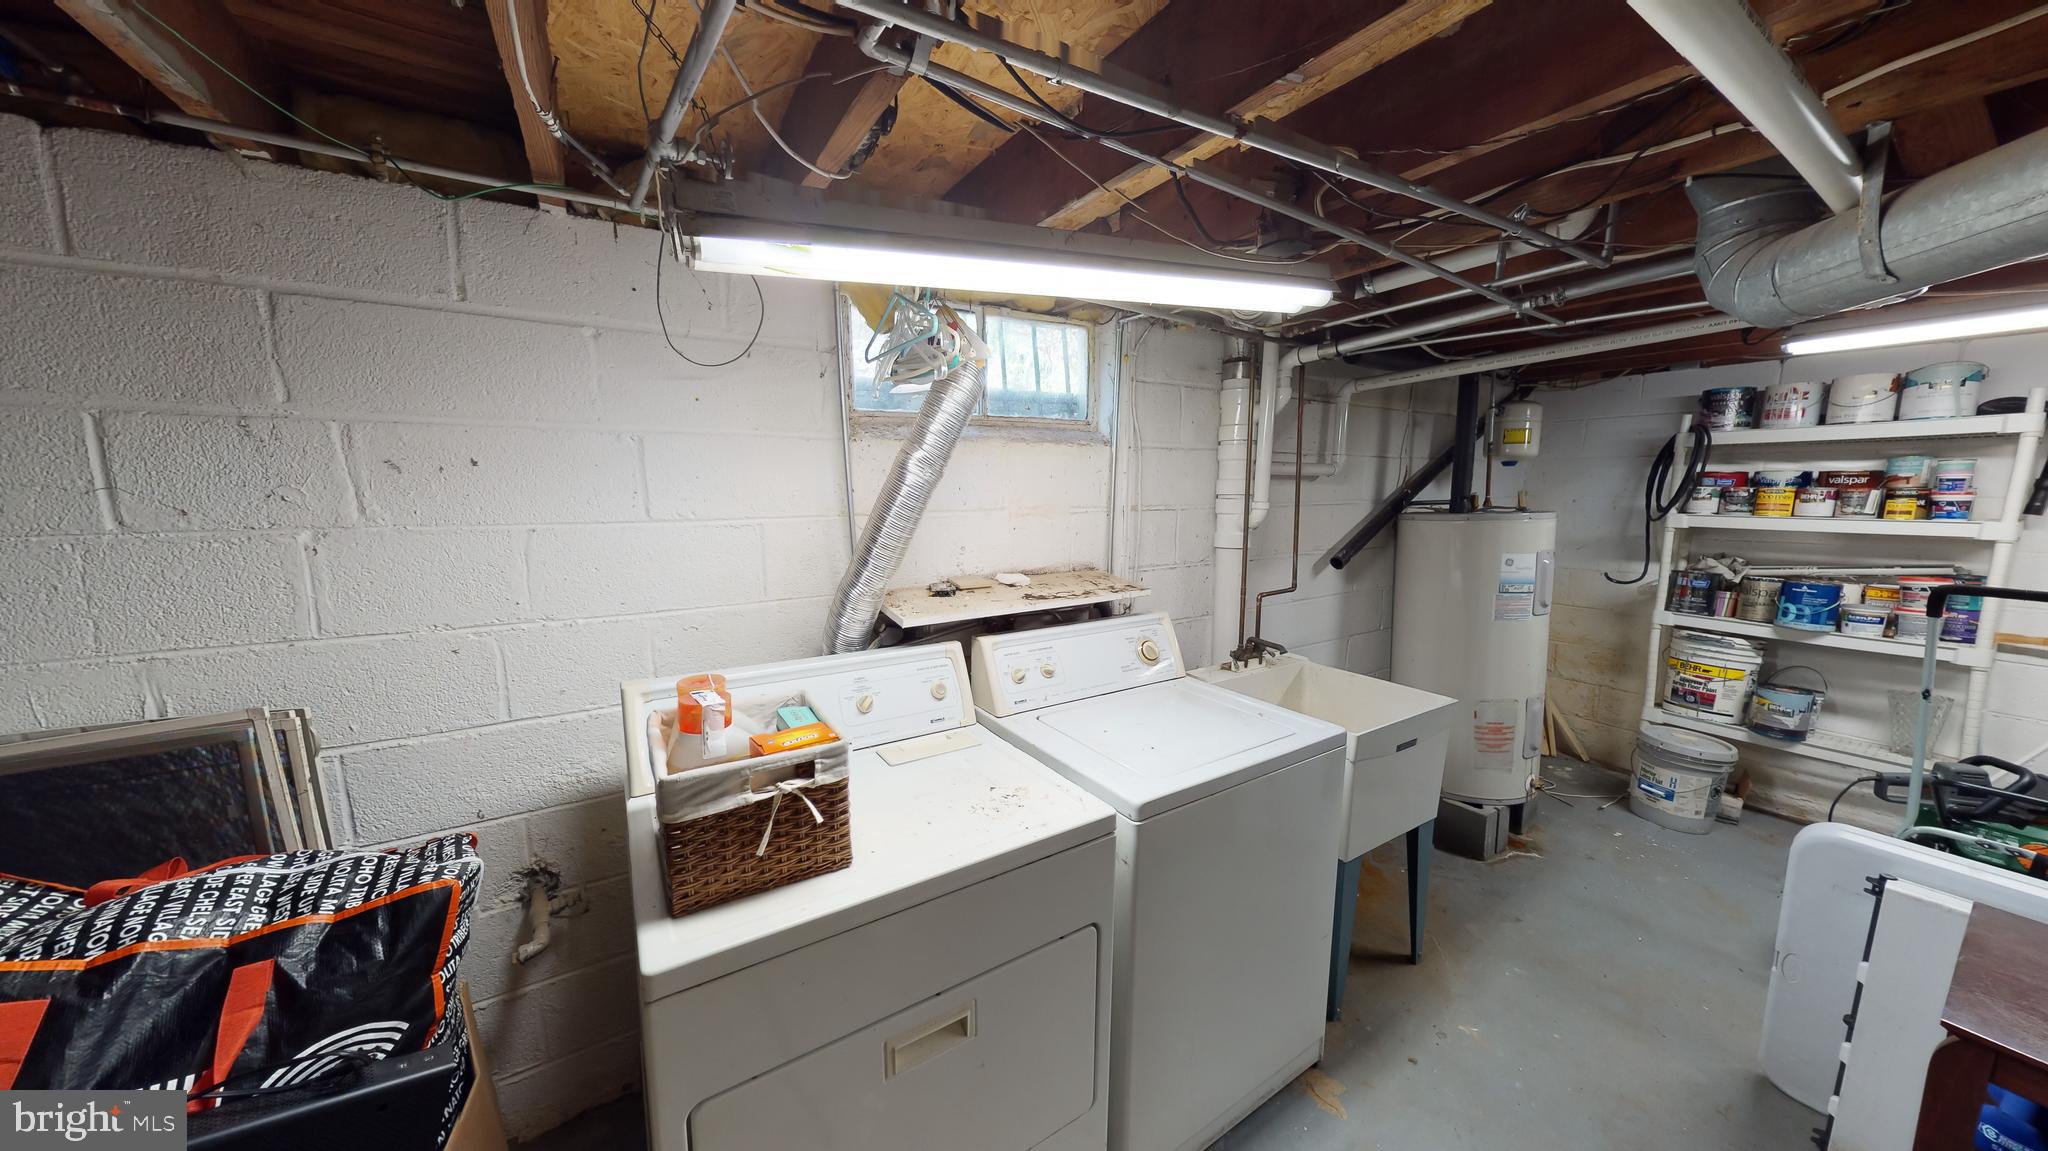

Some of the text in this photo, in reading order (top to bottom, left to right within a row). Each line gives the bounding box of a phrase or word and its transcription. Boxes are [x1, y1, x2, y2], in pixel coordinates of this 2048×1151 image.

[1828, 475, 1870, 485] valspar
[1680, 661, 1702, 673] BEHR
[324, 859, 355, 896] NOLITA
[355, 854, 378, 885] OHO
[179, 890, 220, 940] CHELSE
[222, 887, 250, 914] EAST
[240, 905, 268, 934] GRE
